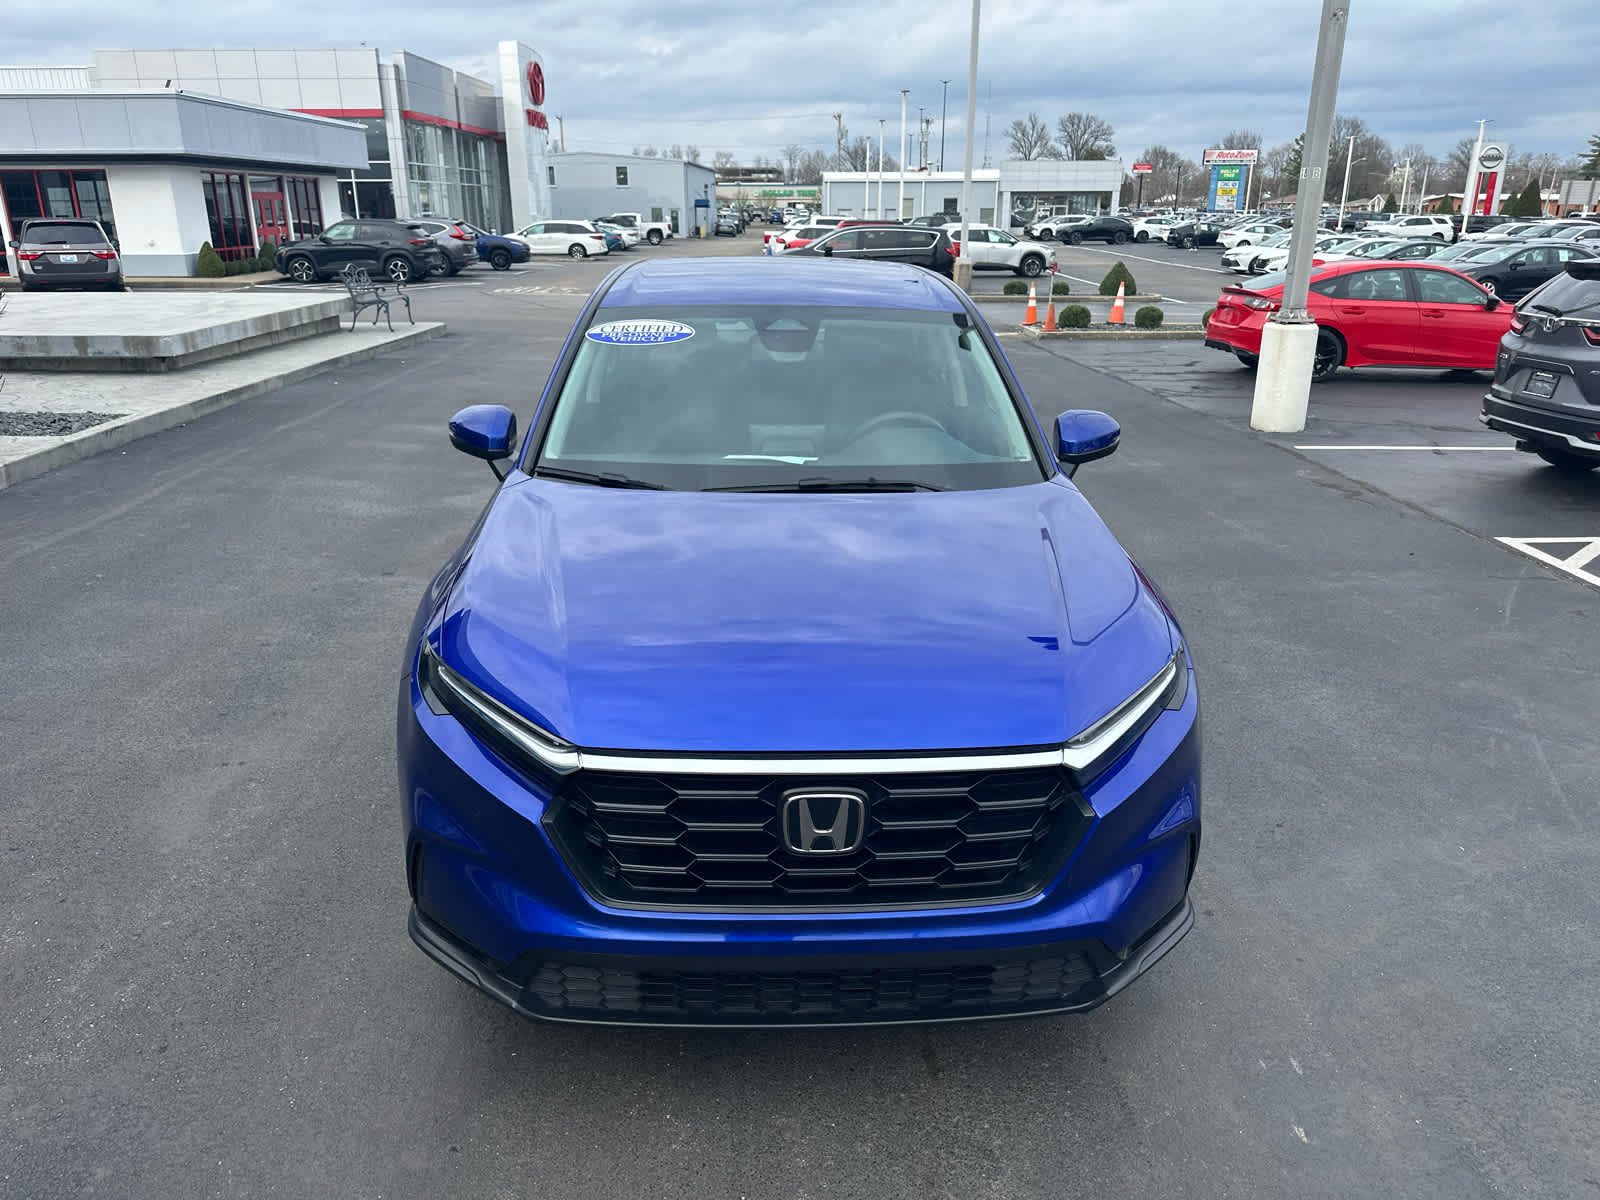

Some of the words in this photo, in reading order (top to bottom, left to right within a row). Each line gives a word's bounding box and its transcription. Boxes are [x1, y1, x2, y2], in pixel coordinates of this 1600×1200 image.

[1216, 151, 1254, 159] AutoZone
[761, 189, 794, 197] DOLLAR
[600, 324, 684, 333] CERTIFIED
